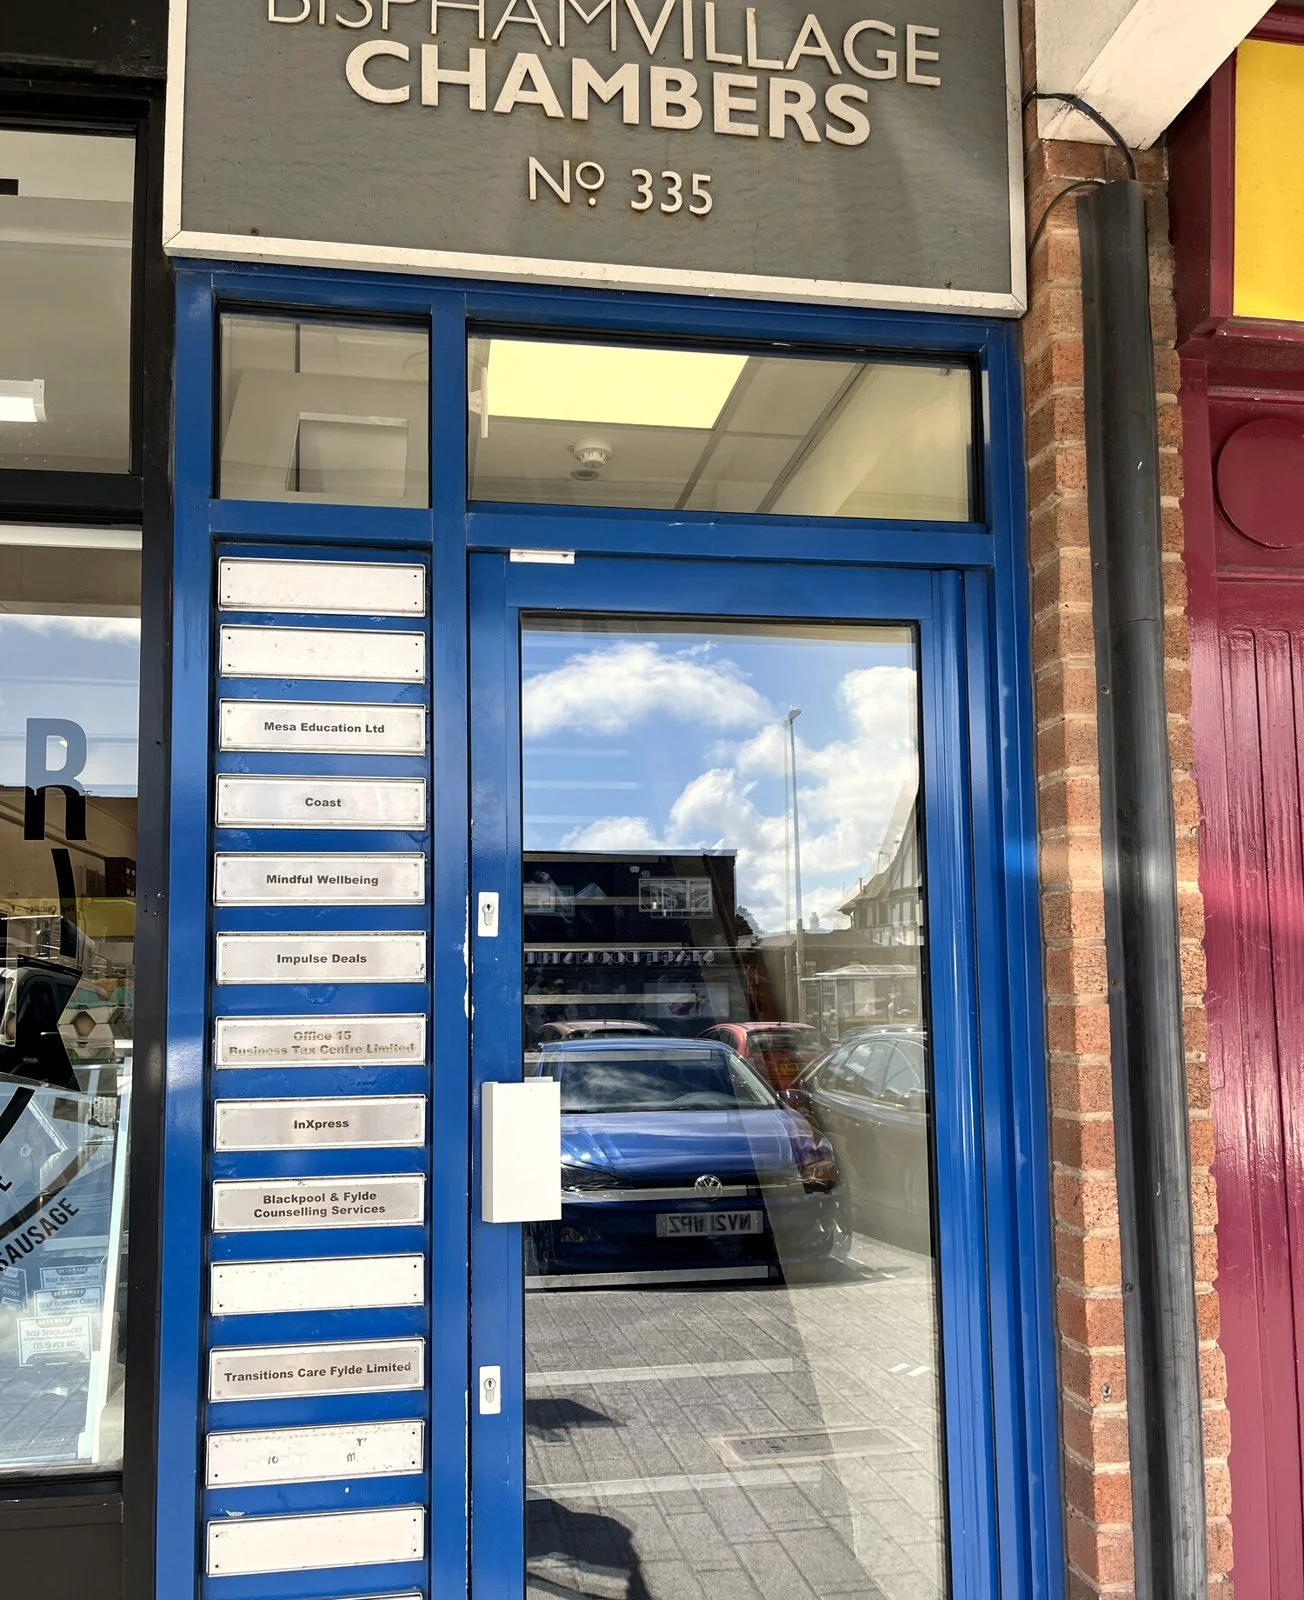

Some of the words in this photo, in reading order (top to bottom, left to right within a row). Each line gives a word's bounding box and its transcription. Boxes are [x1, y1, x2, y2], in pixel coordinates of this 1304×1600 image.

[345, 40, 872, 146] CHAMBERS
[630, 168, 713, 215] 335
[264, 721, 297, 732] Mesa
[300, 722, 362, 733] Education
[365, 723, 385, 734] Ltd
[304, 797, 342, 808] Coast
[266, 873, 313, 884] Mindful
[316, 874, 379, 888] Wellbeing
[276, 953, 328, 966] Impulse
[331, 953, 368, 964] Deals
[293, 1030, 332, 1041] Office
[336, 1030, 352, 1041] 15
[229, 1045, 288, 1056] Business
[291, 1045, 316, 1055] Tax
[319, 1044, 363, 1055] Centre
[366, 1042, 415, 1054] Limited
[293, 1118, 350, 1132] InXpress
[263, 1192, 326, 1205] Blackpool
[329, 1192, 340, 1202] &
[343, 1190, 377, 1203] Fylde
[253, 1206, 328, 1219] Counselling
[331, 1204, 386, 1215] Services
[223, 1369, 294, 1383] Transitions
[297, 1367, 327, 1378] Care
[330, 1365, 363, 1378] Fylde
[366, 1361, 412, 1374] Limited
